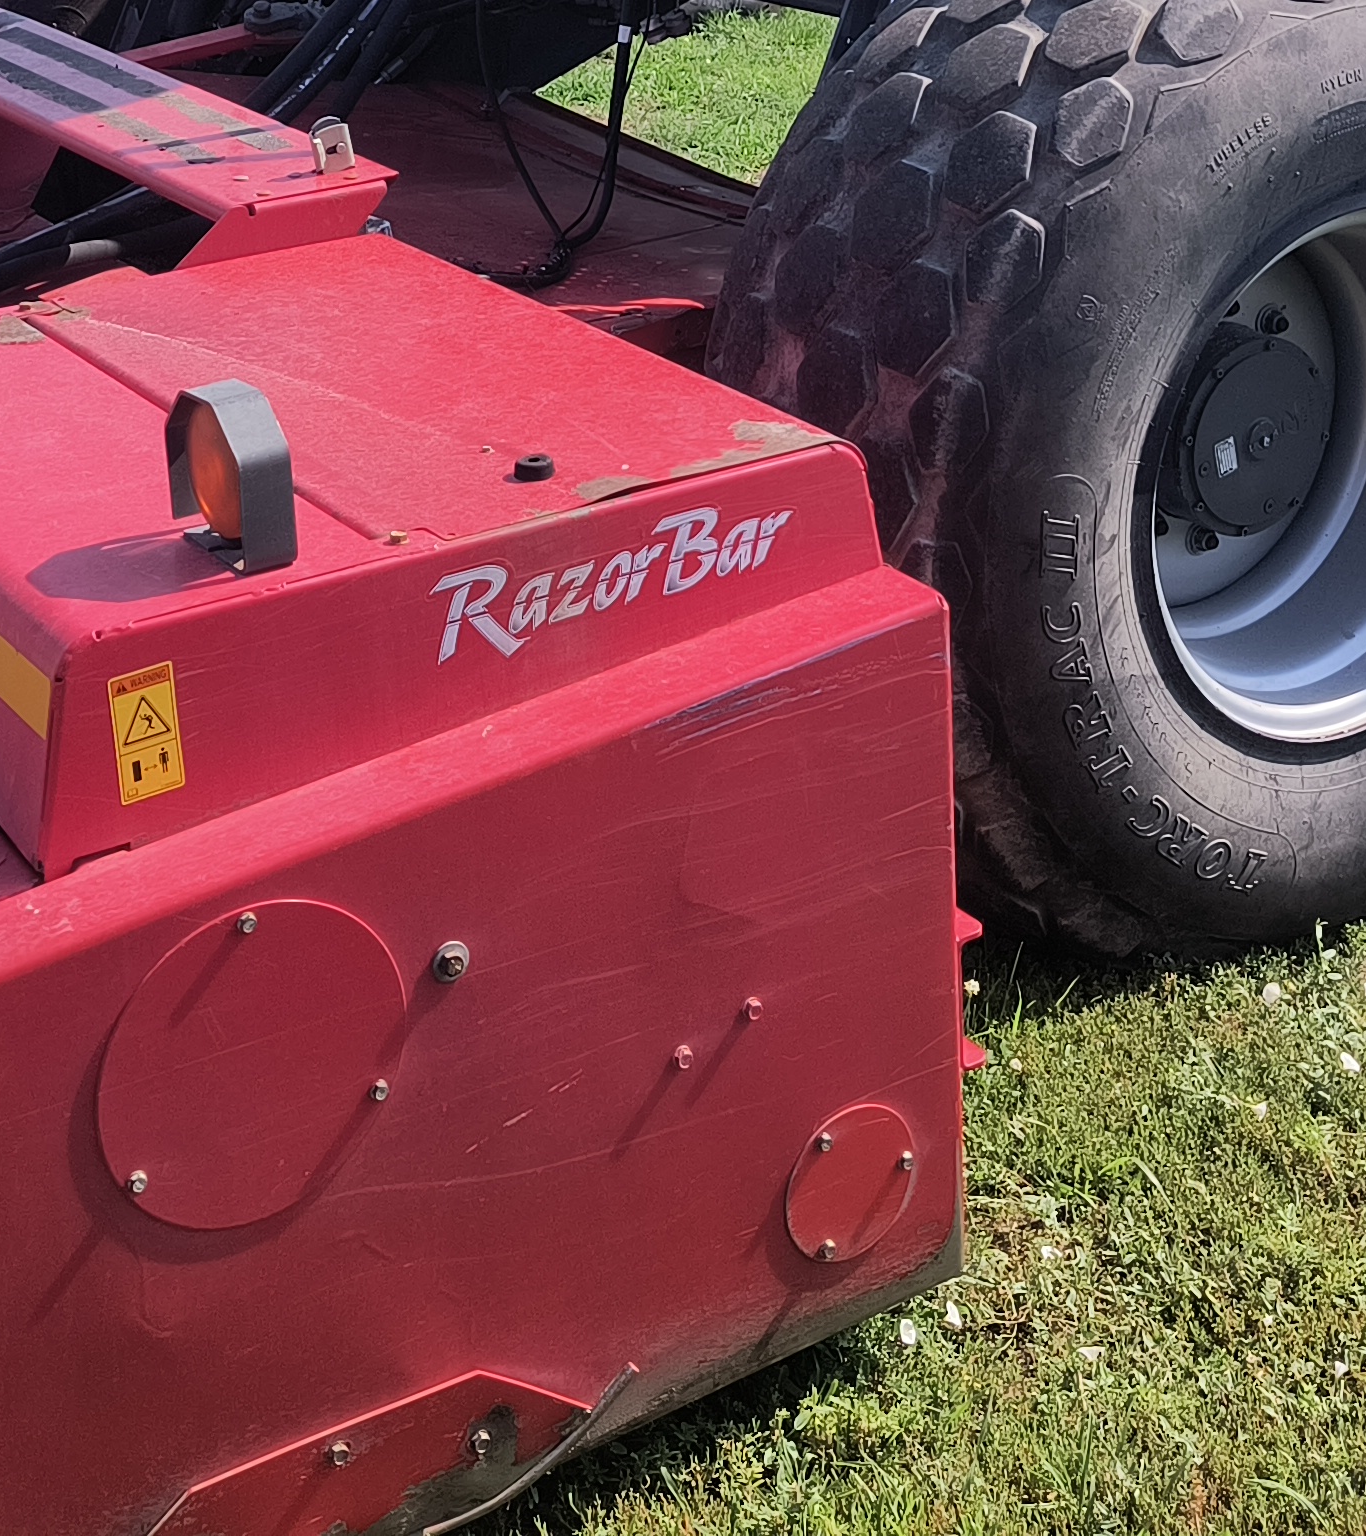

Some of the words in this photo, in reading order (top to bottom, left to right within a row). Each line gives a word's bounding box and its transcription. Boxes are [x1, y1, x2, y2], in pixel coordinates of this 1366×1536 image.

[1320, 68, 1363, 95] NYLON
[1205, 112, 1273, 173] TUBELESS
[129, 668, 168, 688] WARNING
